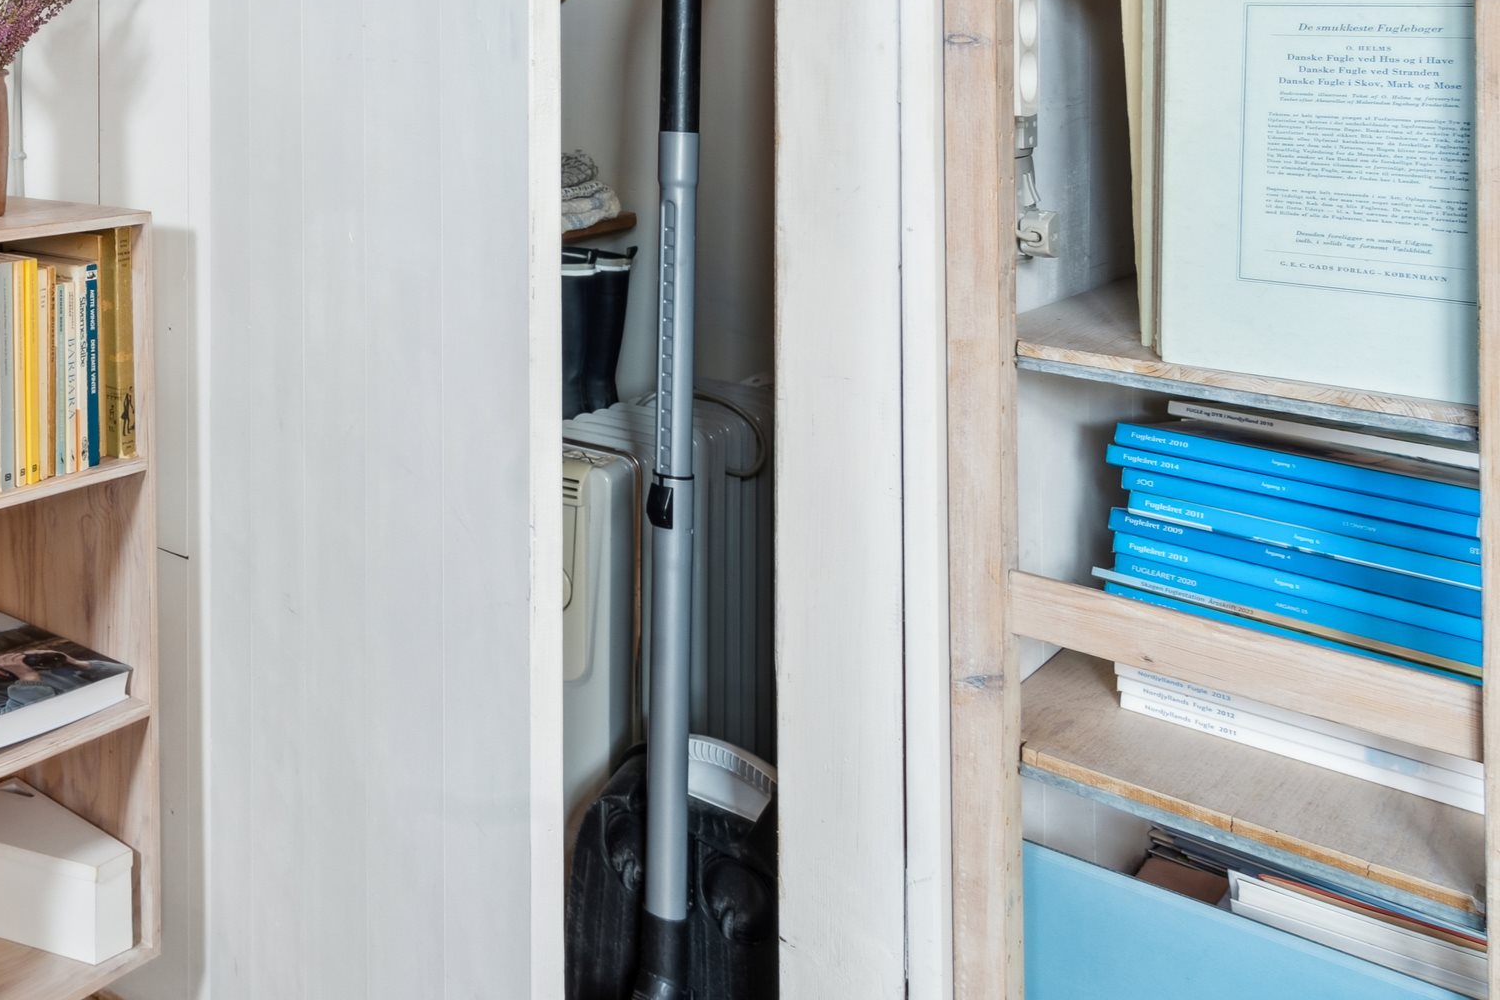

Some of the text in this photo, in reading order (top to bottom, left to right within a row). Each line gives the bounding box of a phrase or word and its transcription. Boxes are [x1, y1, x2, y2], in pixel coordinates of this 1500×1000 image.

[1287, 53, 1323, 62] Danske
[1326, 54, 1354, 64] Fugle
[1358, 54, 1376, 63] ved
[1379, 55, 1401, 64] Hus
[1403, 57, 1415, 65] og
[1426, 56, 1455, 65] Have
[1298, 65, 1440, 77] Danske Fugle ved Stranden
[1278, 76, 1462, 90] Danske Fugle Mark og Mose
[1337, 266, 1376, 275] FORLAG
[67, 337, 76, 421] BARBARA
[1131, 431, 1189, 448] Fugleåret 2010
[1123, 453, 1180, 470] Fugleåret 2014
[1144, 500, 1205, 519] Fugleåret 2011
[1124, 515, 1184, 535] Fugleåret 2009
[1128, 542, 1189, 563] Fugleåret 2013
[1131, 564, 1197, 587] FUGLEÅRET 2020
[1137, 670, 1184, 688] Nordjyllands
[1143, 687, 1235, 720] Nordjyllands Fugle 2012
[1144, 704, 1237, 736] Nordjyllands Fugle 2011
